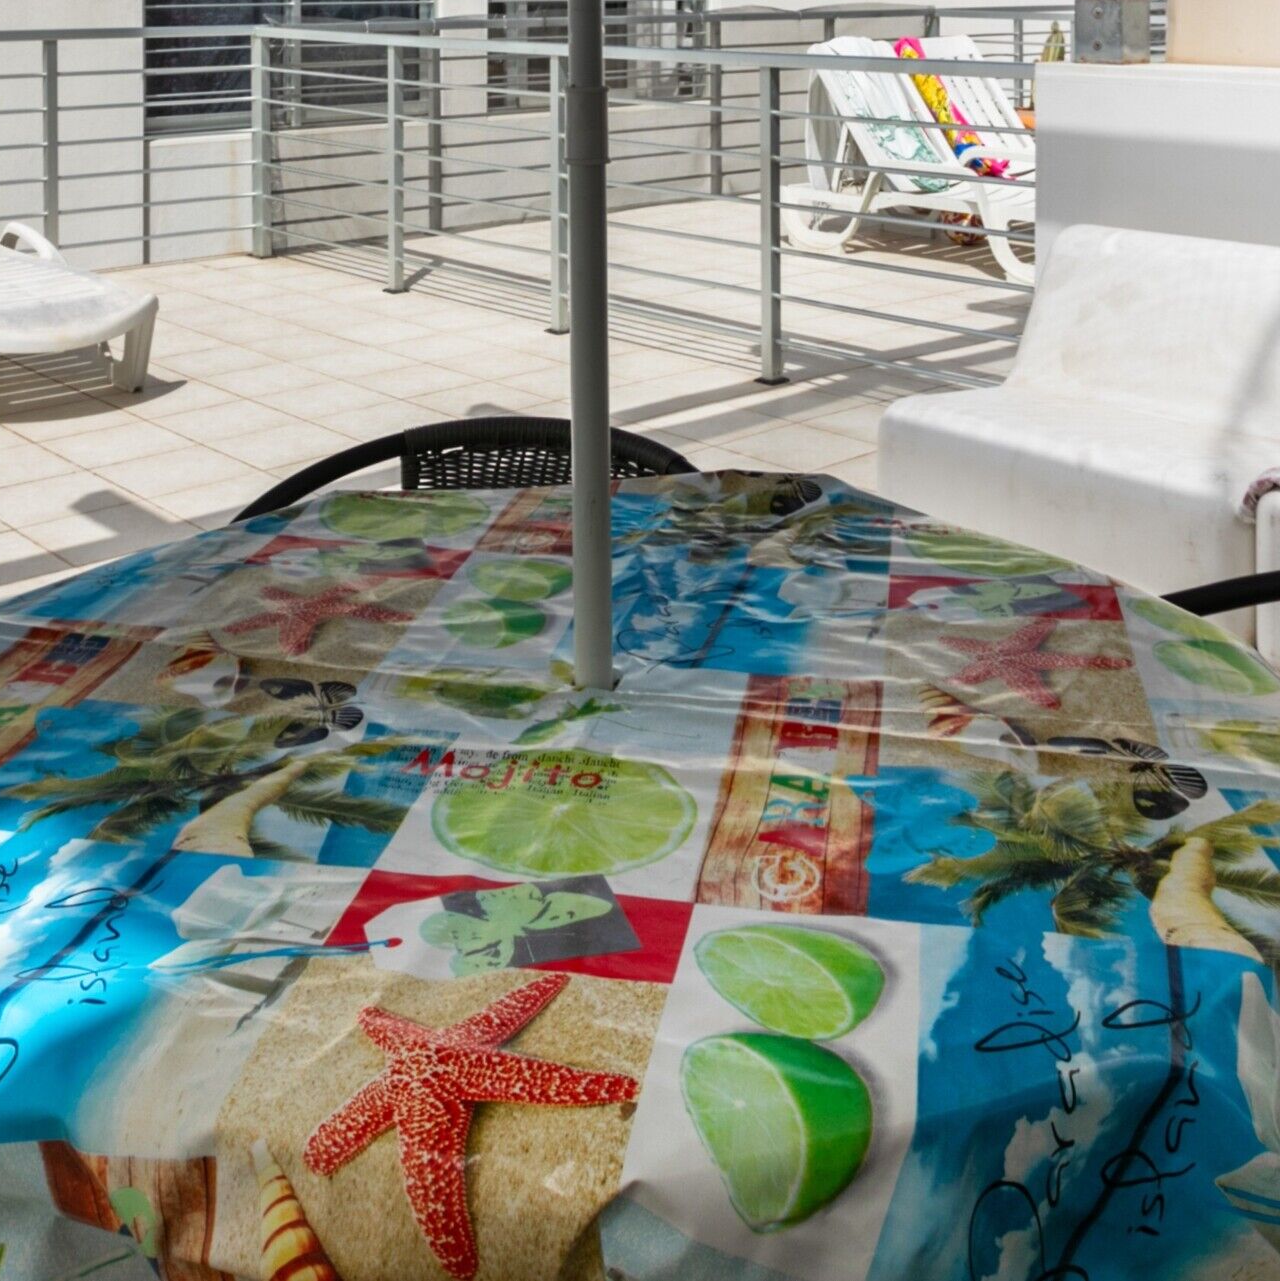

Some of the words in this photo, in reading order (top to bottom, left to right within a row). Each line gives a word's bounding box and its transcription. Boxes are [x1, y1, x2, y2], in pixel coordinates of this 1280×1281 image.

[399, 747, 603, 790] Mojito
[14, 880, 164, 1005] island
[1102, 991, 1201, 1237] island
